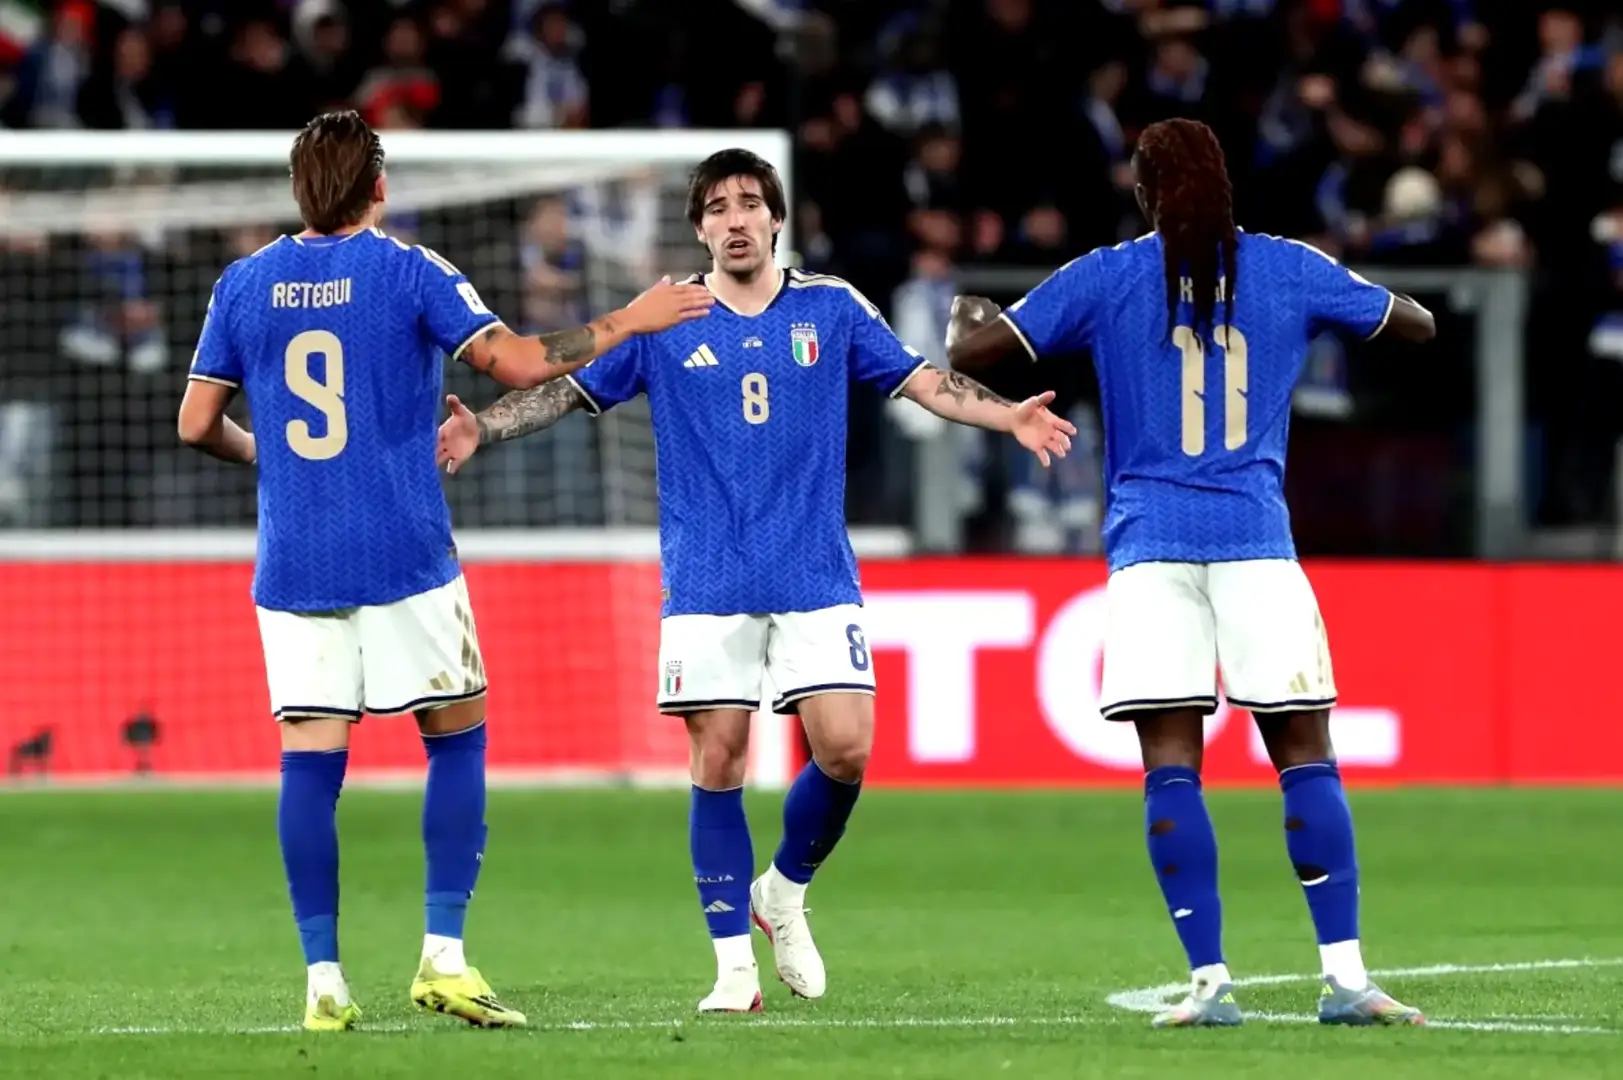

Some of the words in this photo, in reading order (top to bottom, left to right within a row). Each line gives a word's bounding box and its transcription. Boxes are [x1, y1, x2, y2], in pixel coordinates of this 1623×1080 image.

[272, 278, 351, 308] RETEGUI
[285, 329, 348, 461] 9
[741, 372, 769, 424] 8
[1172, 325, 1248, 456] 11
[845, 623, 869, 671] 8
